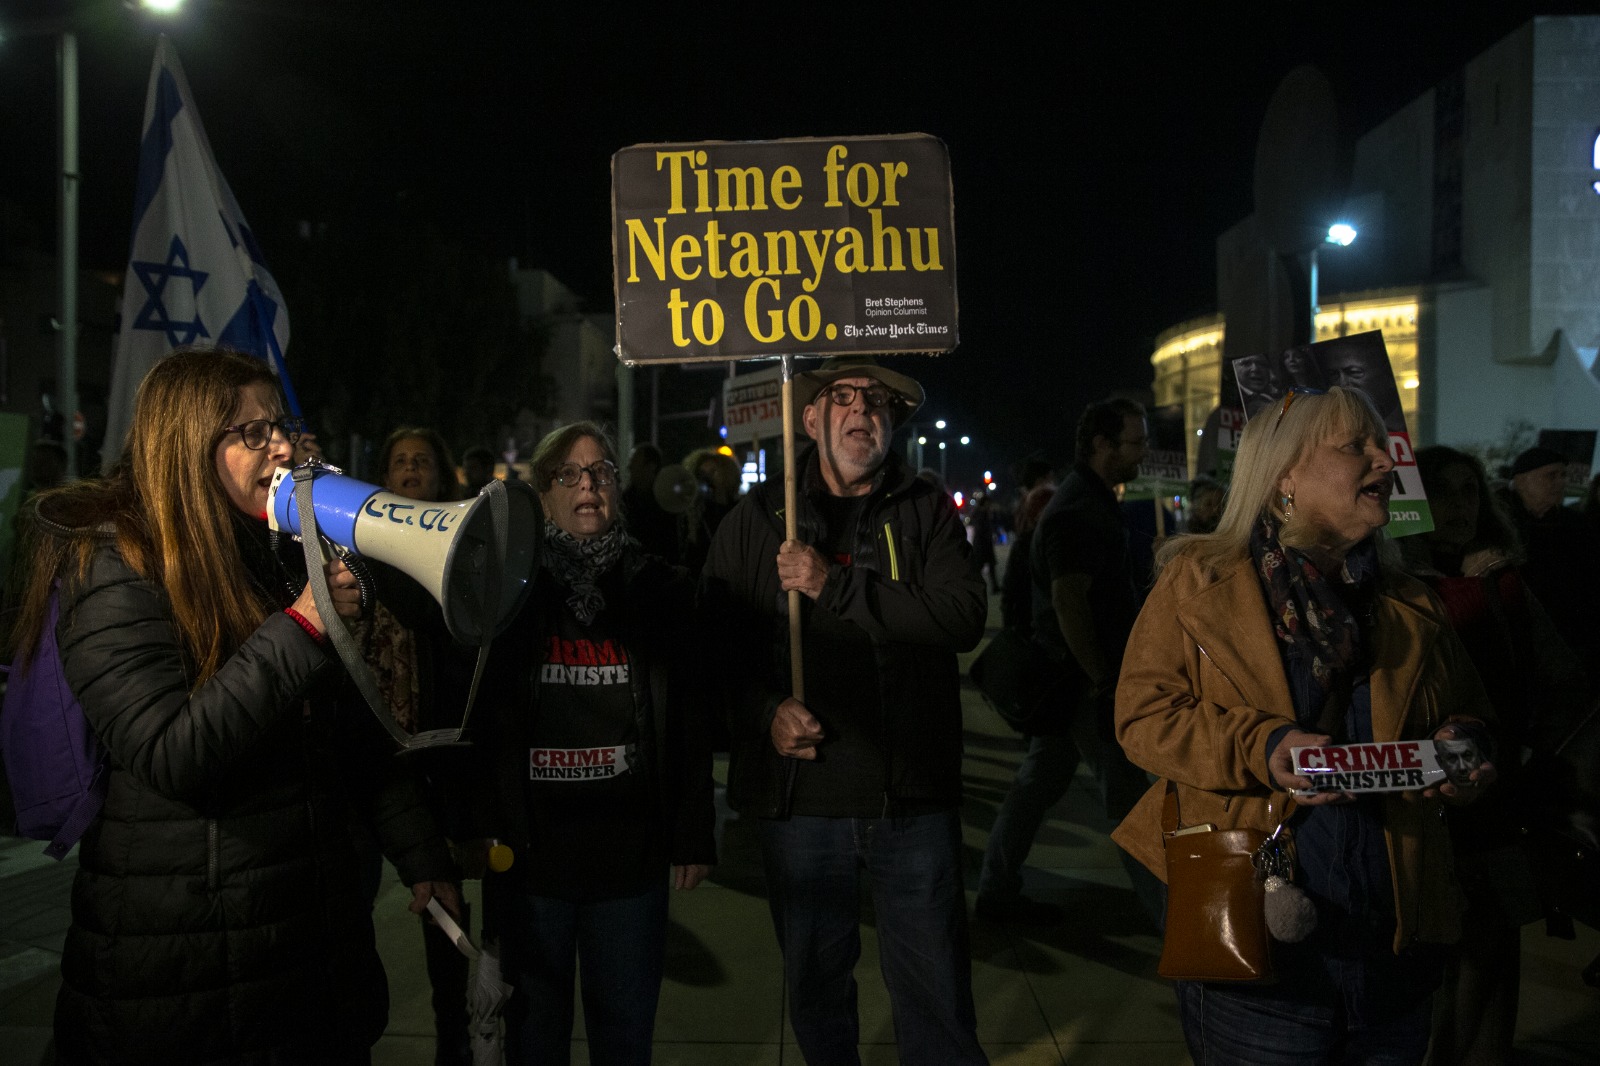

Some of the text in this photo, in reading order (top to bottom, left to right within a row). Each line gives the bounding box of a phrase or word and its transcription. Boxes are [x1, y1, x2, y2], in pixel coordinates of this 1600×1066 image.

[656, 144, 908, 215] Time for
[625, 208, 944, 293] Netanyahu
[667, 277, 838, 348] to Go.
[865, 297, 924, 308] Bret Stephens
[865, 307, 928, 318] Opinion Columnist
[844, 322, 949, 339] The New York Times
[728, 400, 781, 426] הביתה
[1389, 510, 1421, 522] מאב
[532, 748, 616, 768] CRIME
[1299, 742, 1422, 774] CRIME
[532, 765, 615, 779] MINISTER
